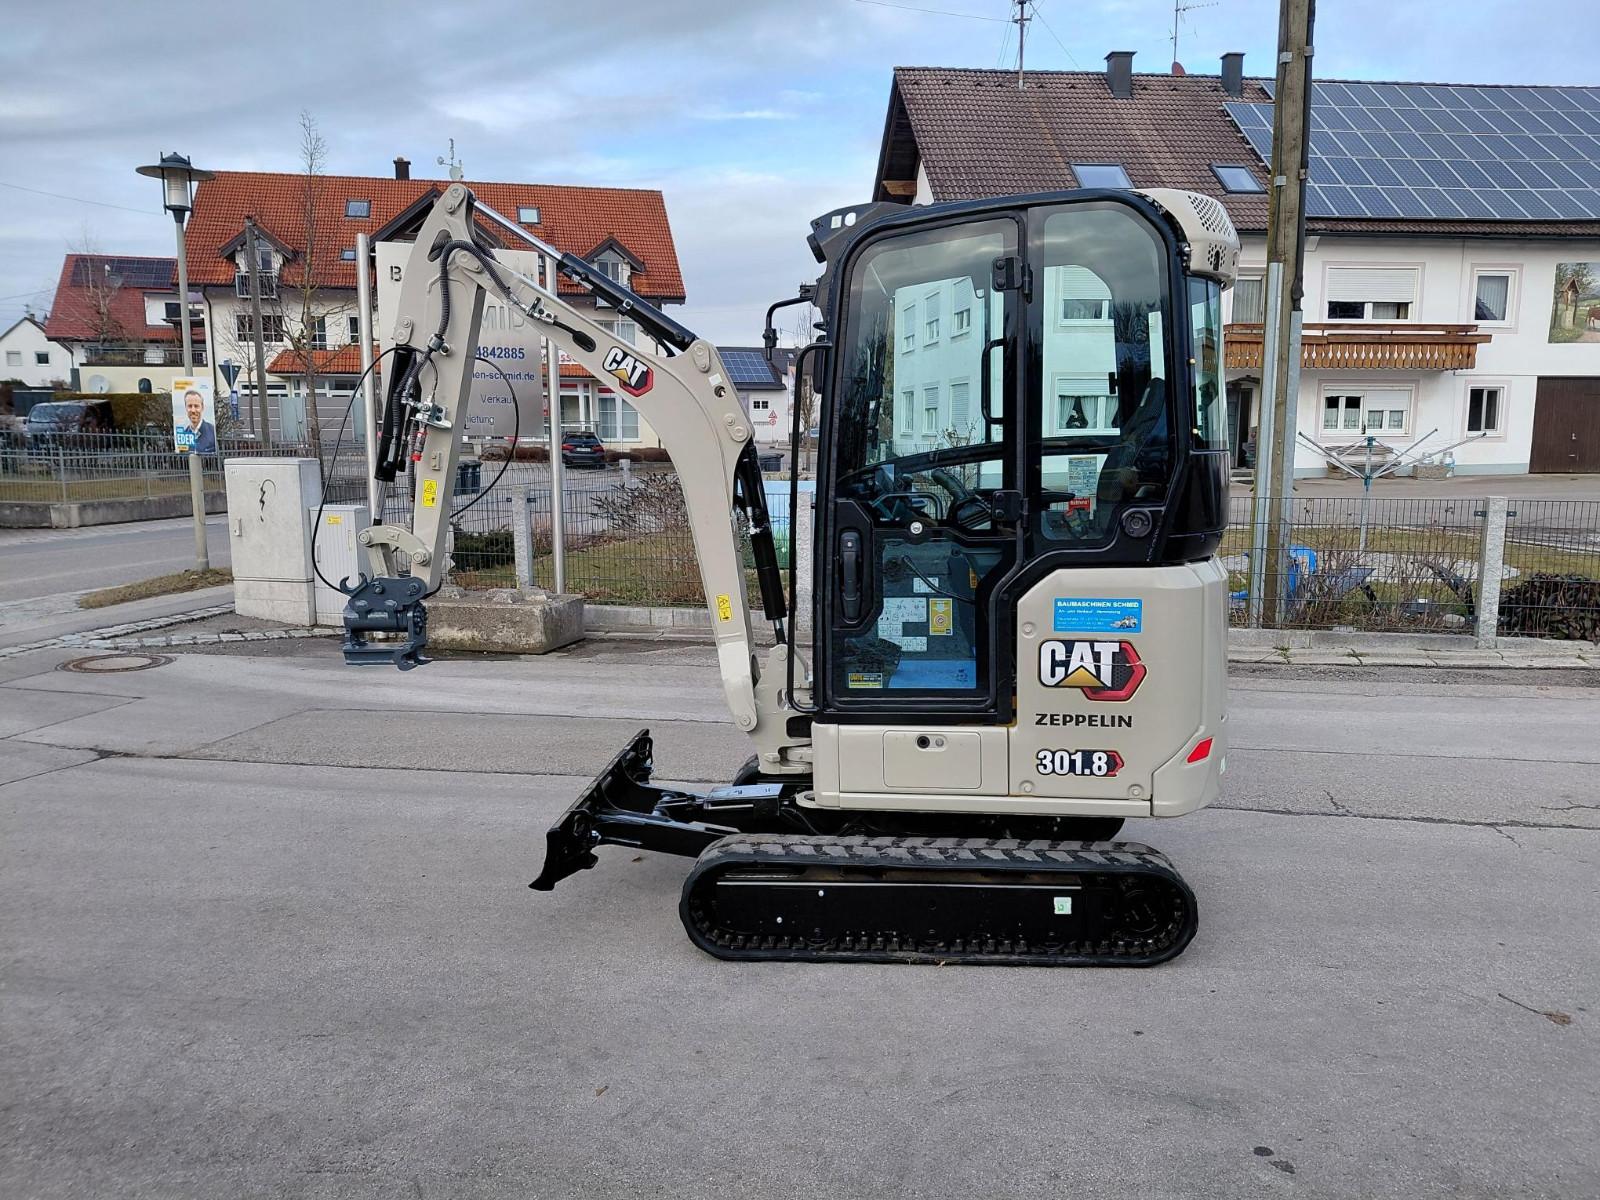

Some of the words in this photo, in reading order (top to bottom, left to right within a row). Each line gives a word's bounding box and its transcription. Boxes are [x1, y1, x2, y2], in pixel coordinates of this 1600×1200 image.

[482, 305, 525, 329] MID
[603, 347, 648, 387] CAT
[480, 394, 514, 404] Verkau
[466, 415, 495, 425] ietung
[177, 434, 195, 445] EDER
[1040, 641, 1120, 687] CAT
[1035, 713, 1133, 728] ZEPPELIN
[1037, 750, 1108, 776] 301.8
